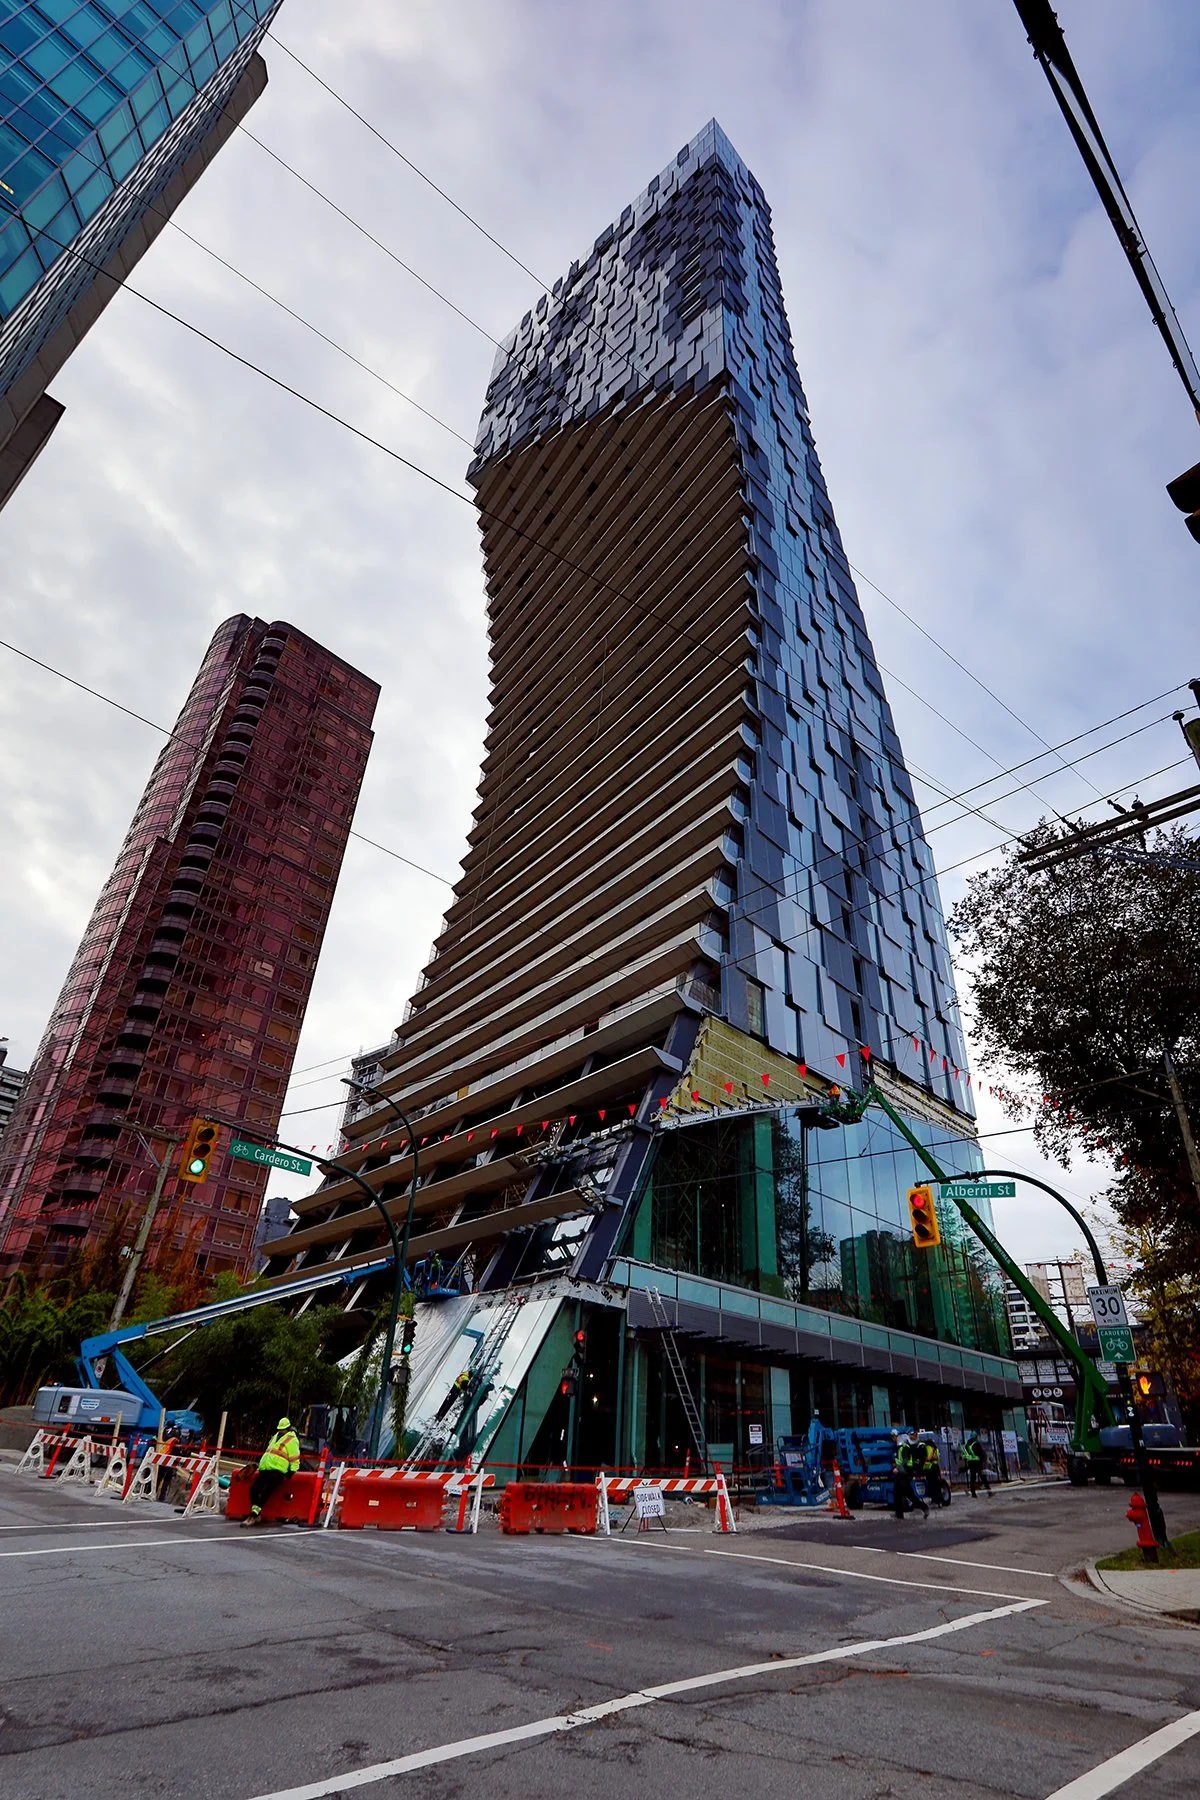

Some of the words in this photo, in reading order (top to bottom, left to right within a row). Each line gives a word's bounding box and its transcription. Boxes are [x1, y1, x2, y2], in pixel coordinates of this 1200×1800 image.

[254, 1149, 289, 1168] Cardero
[291, 1160, 303, 1172] St.
[946, 1185, 992, 1197] Alberni
[997, 1185, 1010, 1196] St
[1090, 1287, 1119, 1295] MAXIMUM
[1095, 1296, 1121, 1317] 30
[1100, 1329, 1130, 1337] CARDERO
[636, 1492, 661, 1502] SIDEWALK
[641, 1503, 661, 1514] CLOSED
